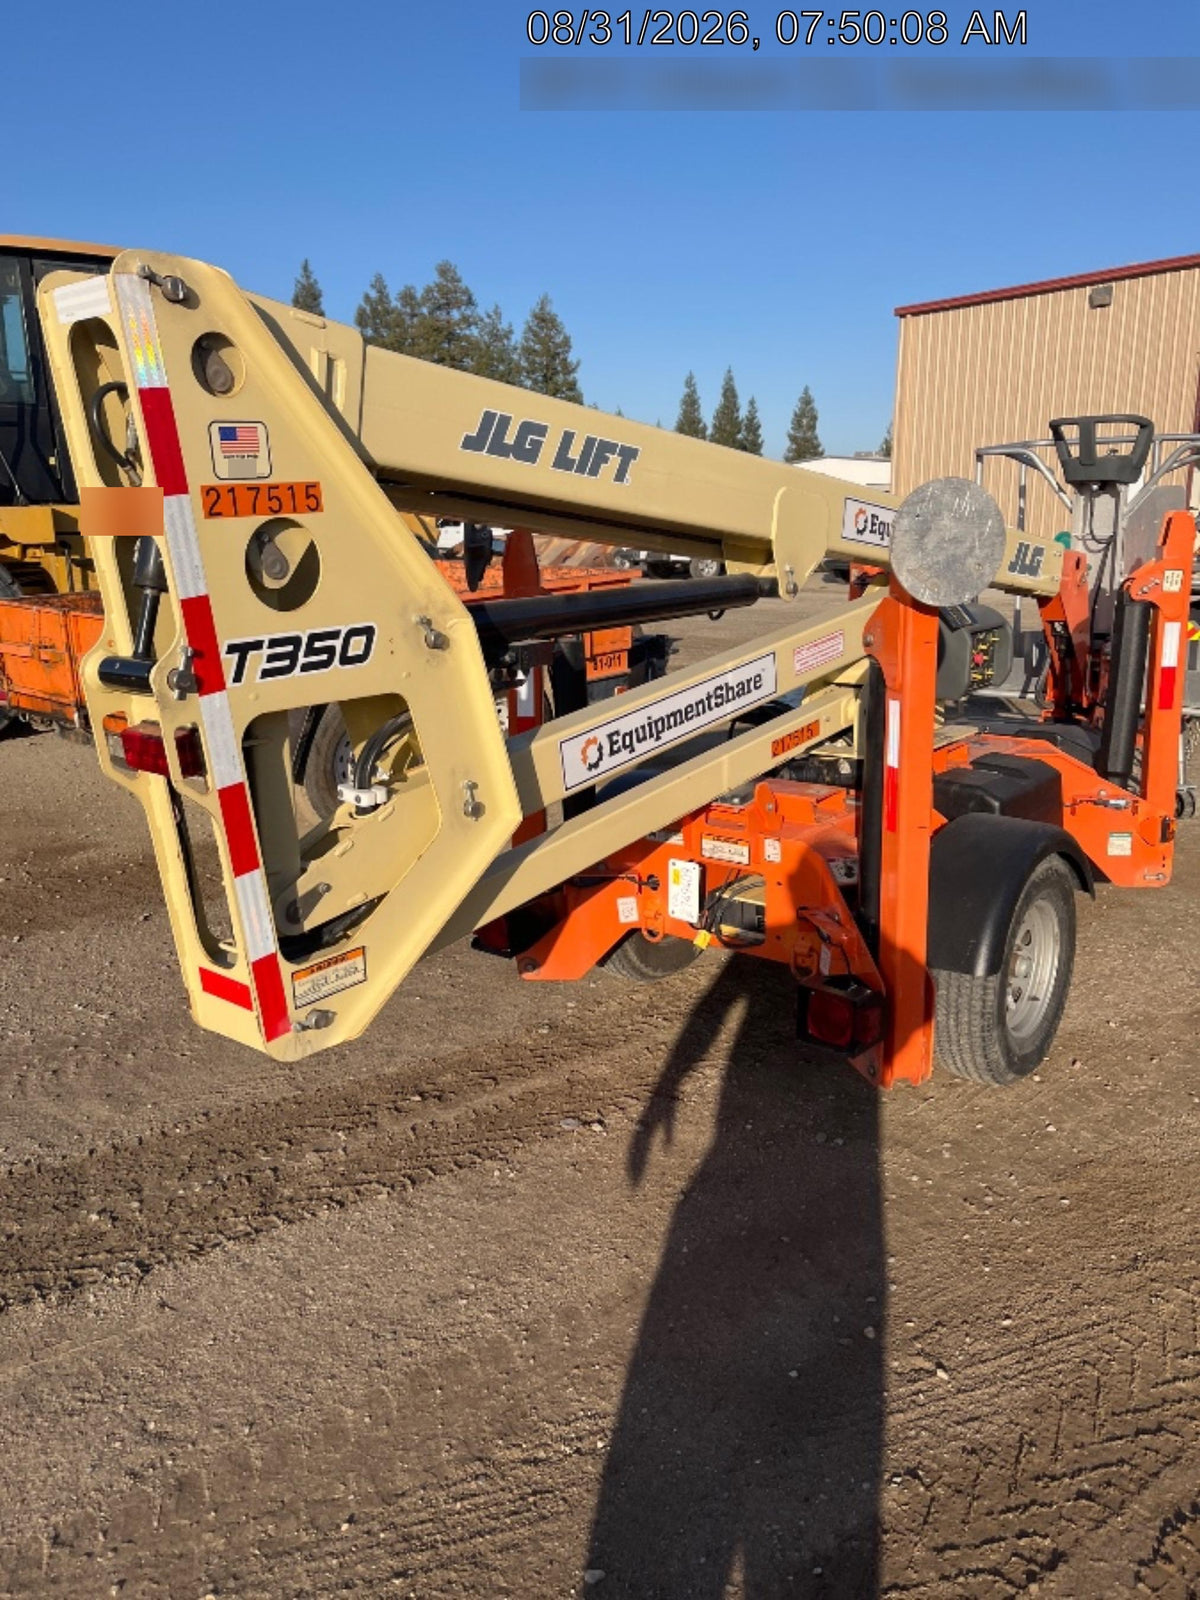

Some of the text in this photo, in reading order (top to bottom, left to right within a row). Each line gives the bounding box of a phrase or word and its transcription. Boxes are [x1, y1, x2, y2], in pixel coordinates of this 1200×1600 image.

[460, 409, 642, 485] JLG LIFT
[205, 484, 320, 517] 217515
[1008, 541, 1045, 577] JLG
[224, 624, 376, 684] T350
[607, 672, 763, 757] EquipmentShare
